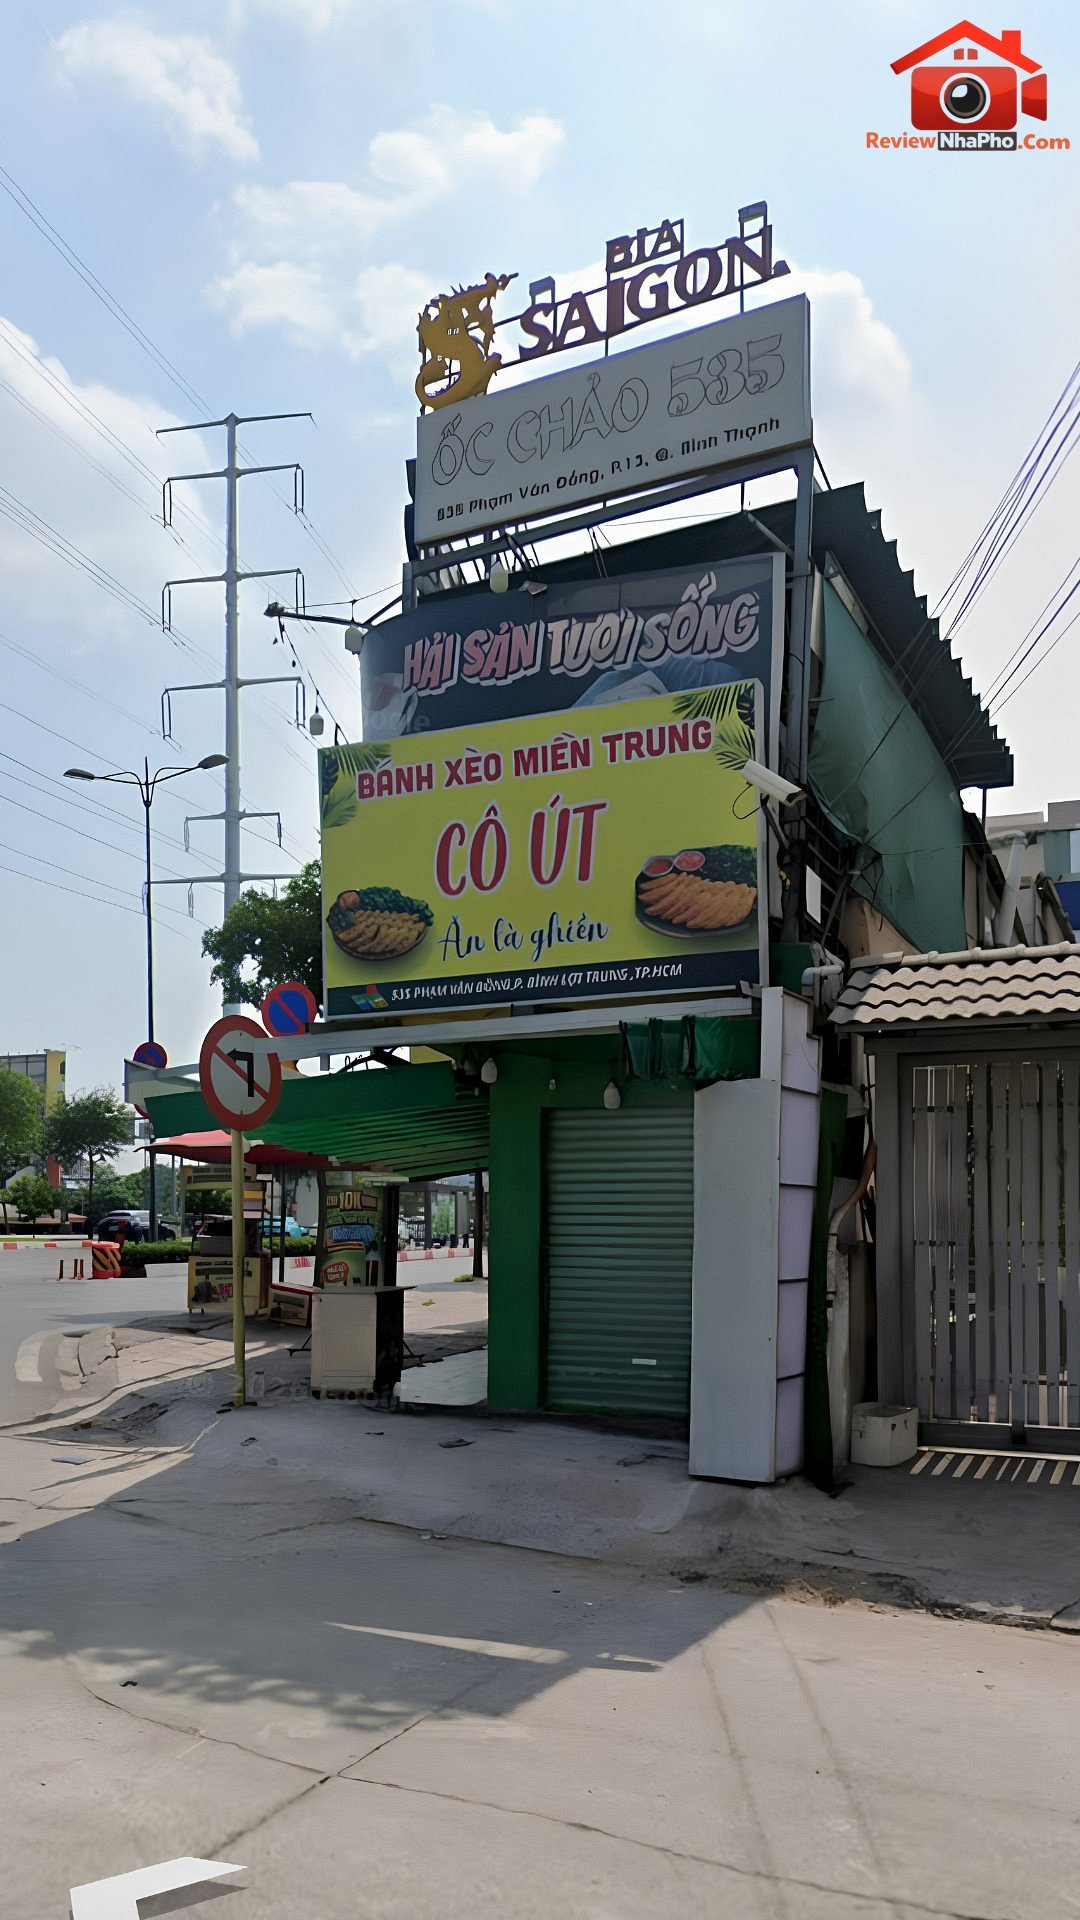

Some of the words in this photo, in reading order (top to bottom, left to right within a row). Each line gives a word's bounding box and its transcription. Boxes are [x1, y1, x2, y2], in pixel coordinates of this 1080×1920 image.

[606, 219, 684, 272] BIA
[431, 413, 496, 486] ỐC
[402, 631, 461, 697] HẢI
[461, 619, 546, 687] SẢN
[638, 571, 760, 668] SỐNG
[357, 758, 434, 800] BÁNH
[444, 746, 502, 789] XÈO
[513, 732, 591, 778] MIỀN
[602, 720, 713, 766] TRUNG
[435, 802, 508, 897] CÔ
[530, 793, 608, 886] ÚT
